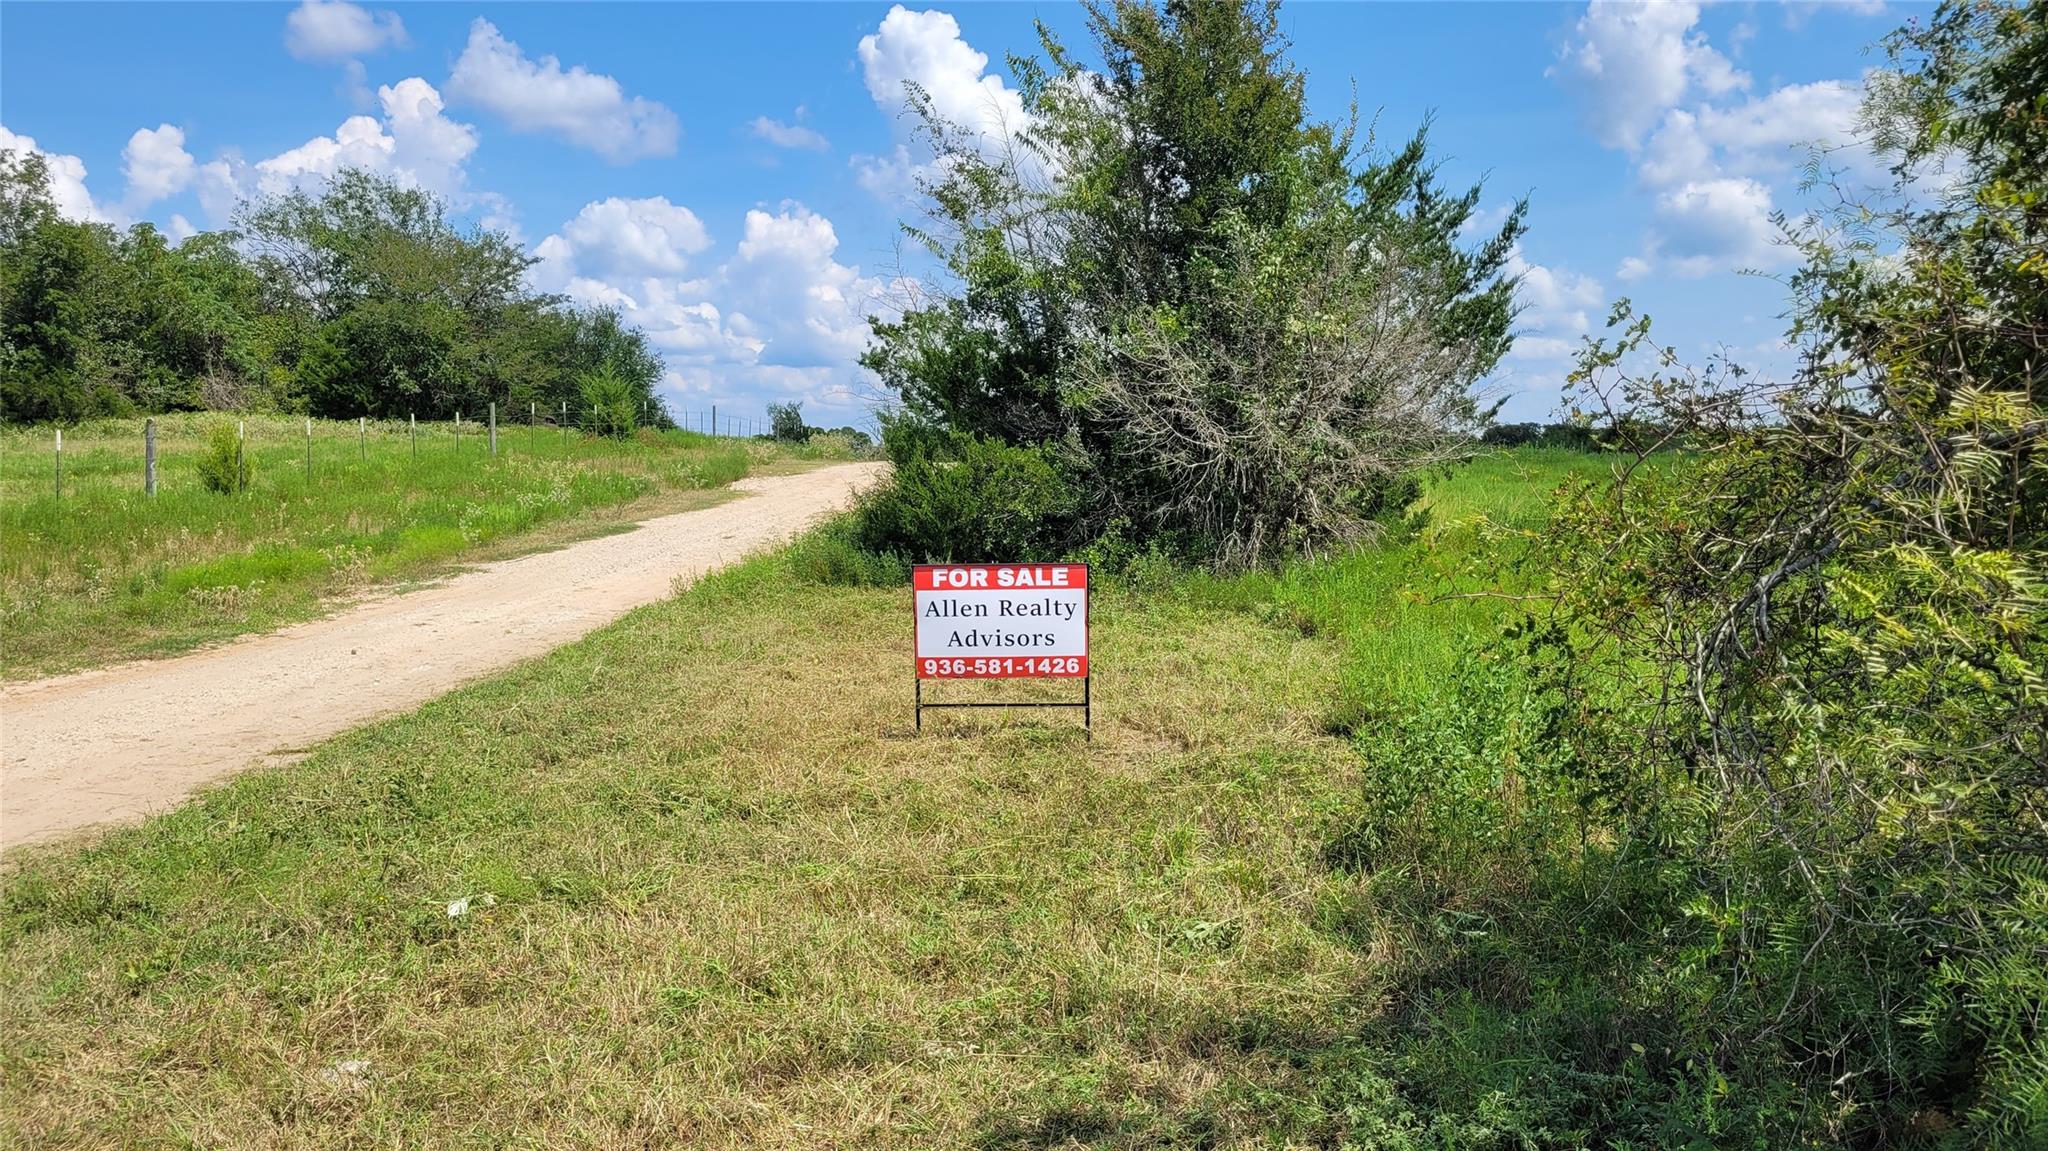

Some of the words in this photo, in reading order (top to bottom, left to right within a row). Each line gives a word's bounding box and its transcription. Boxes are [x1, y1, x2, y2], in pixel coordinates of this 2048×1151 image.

[932, 568, 988, 587] FOR
[997, 567, 1069, 586] SALE
[925, 599, 988, 617] Allen
[999, 598, 1077, 621] Realty
[947, 629, 1055, 647] Advisors
[924, 658, 1080, 675] 936-581-1426
